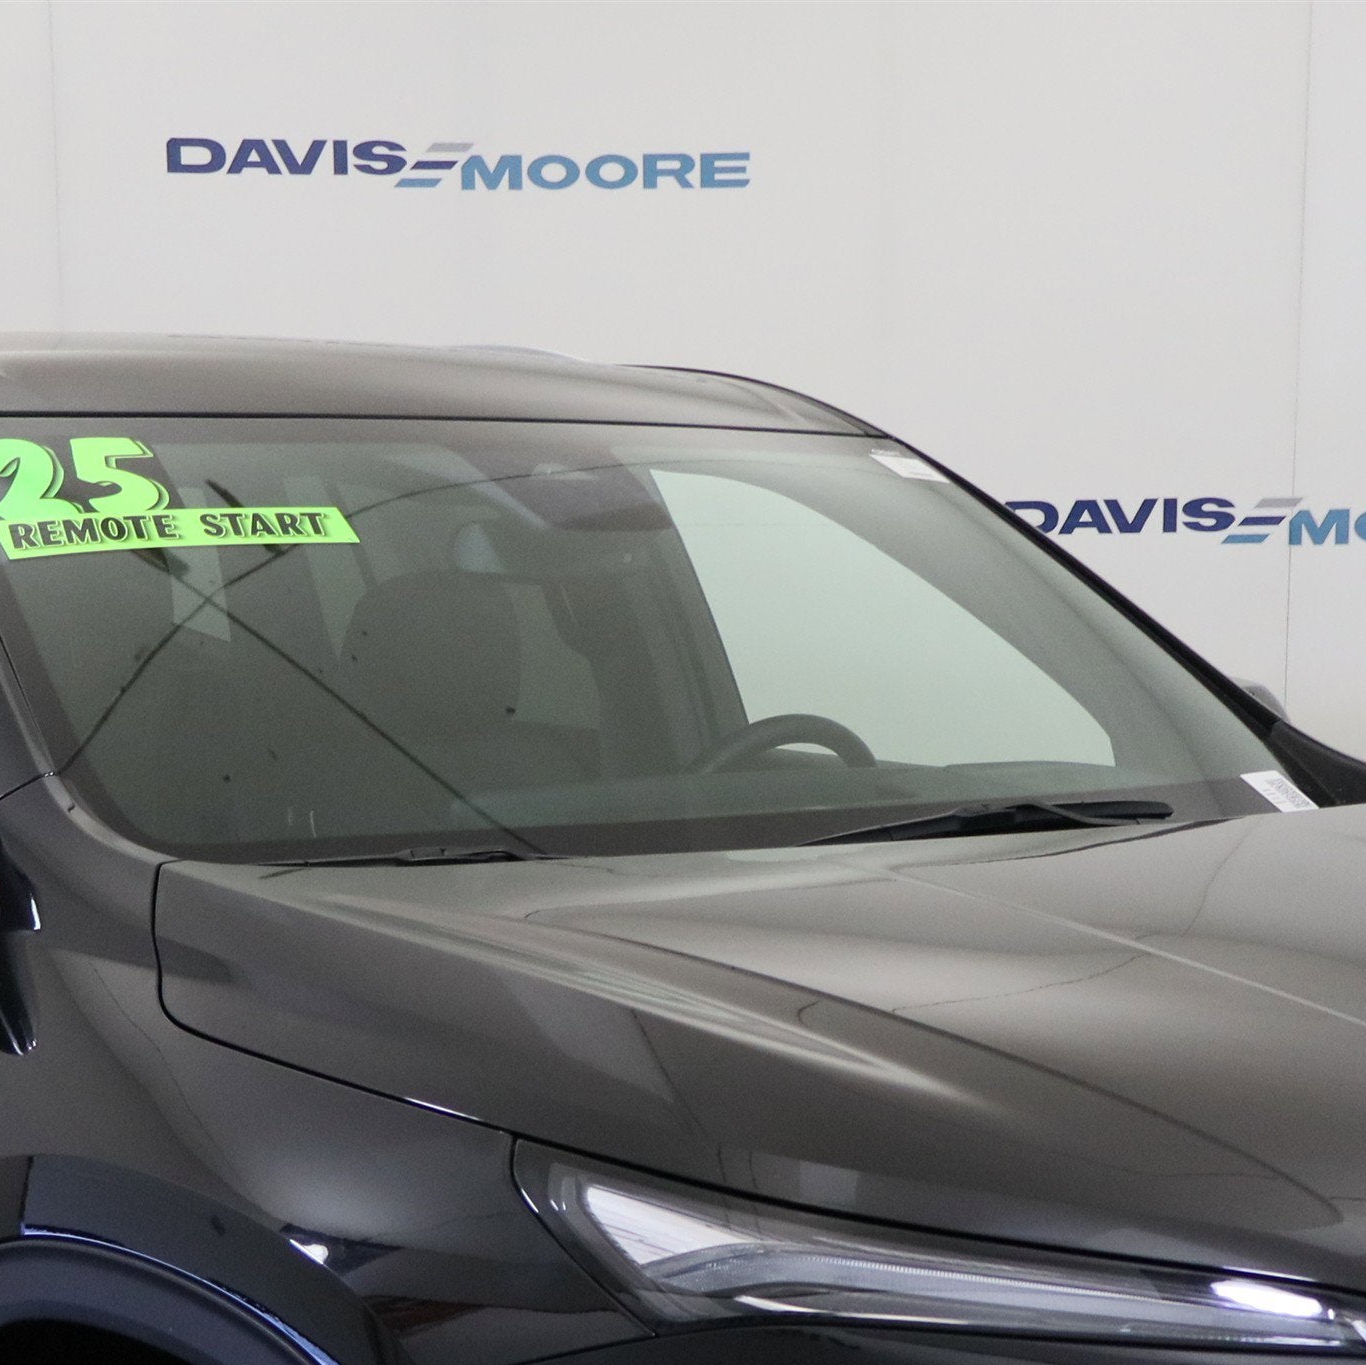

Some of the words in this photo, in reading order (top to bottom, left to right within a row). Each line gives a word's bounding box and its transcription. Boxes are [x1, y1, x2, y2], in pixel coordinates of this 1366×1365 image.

[166, 137, 408, 175] DAVIS
[460, 152, 750, 190] MOORE
[8, 513, 181, 551] REMOTE
[199, 511, 327, 537] START
